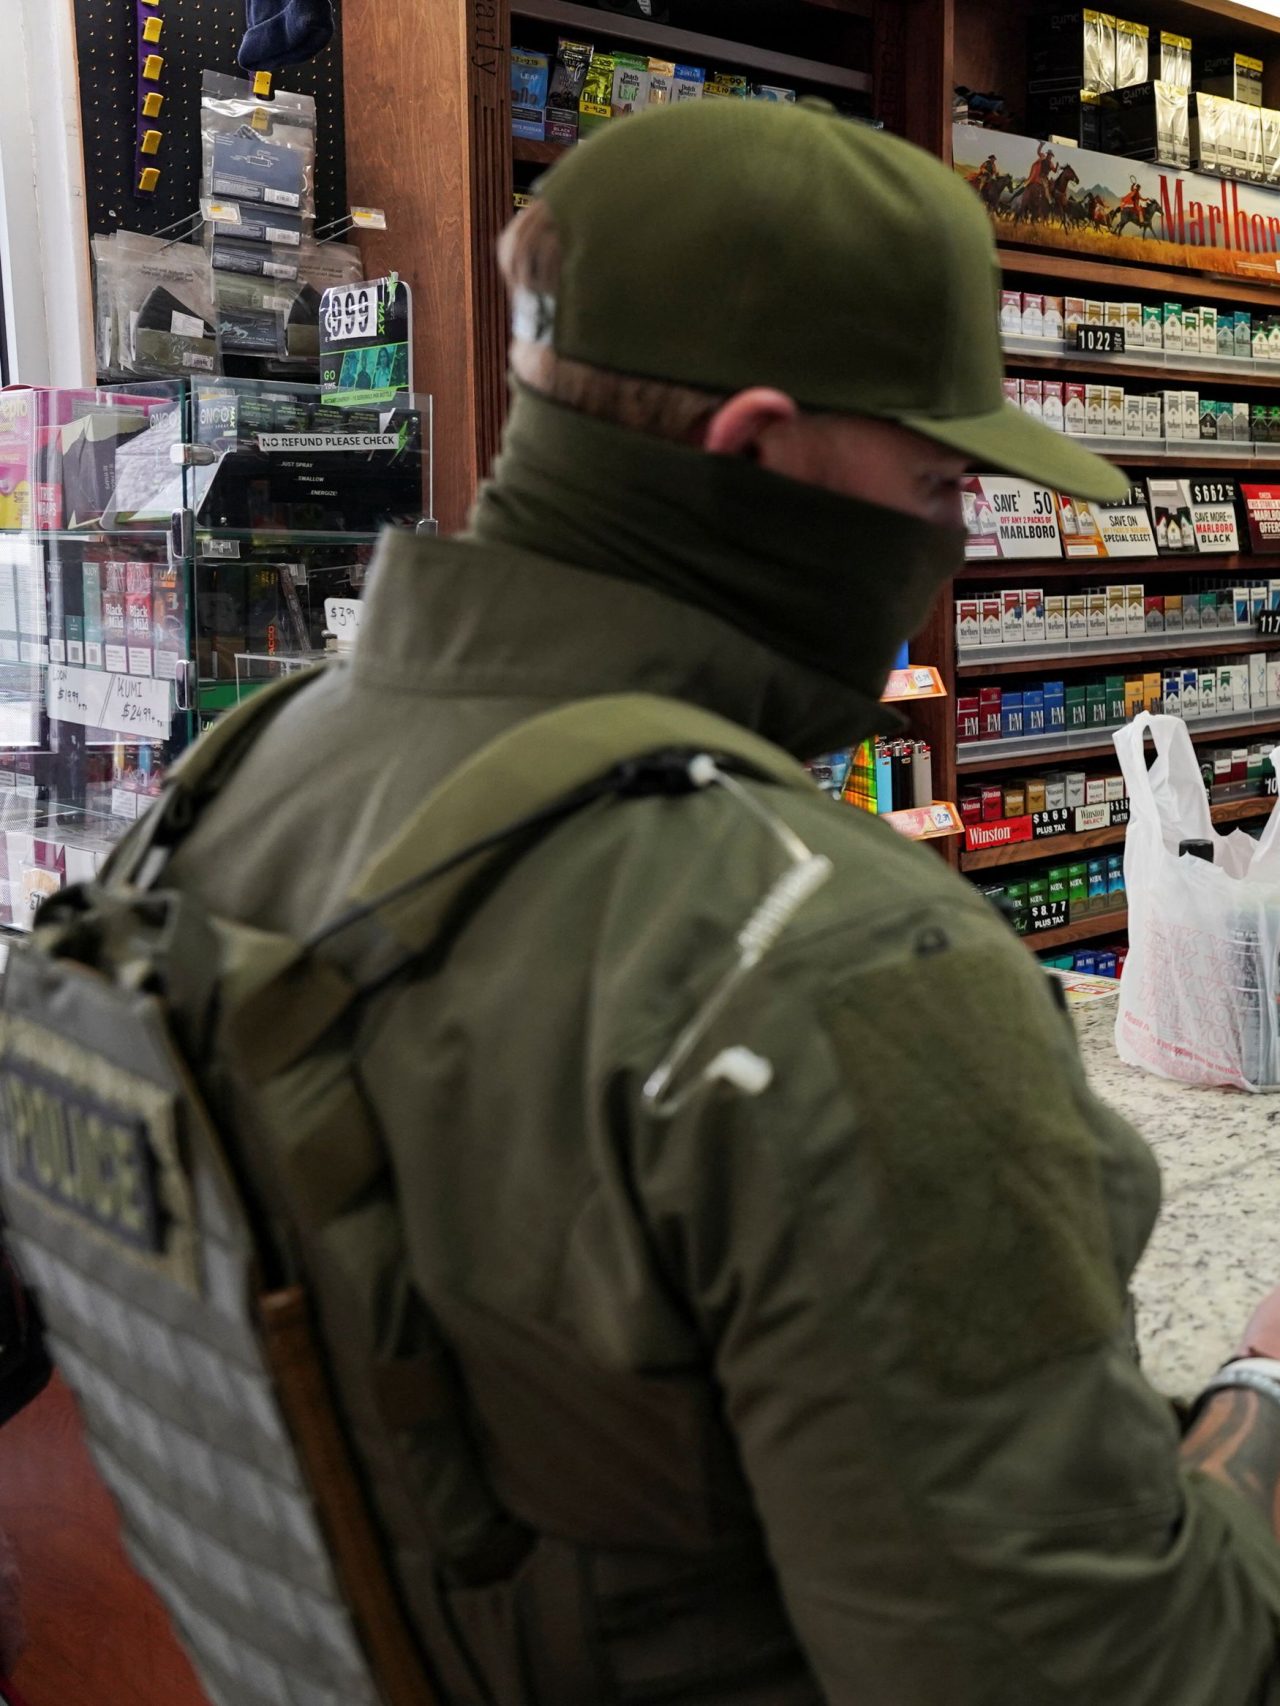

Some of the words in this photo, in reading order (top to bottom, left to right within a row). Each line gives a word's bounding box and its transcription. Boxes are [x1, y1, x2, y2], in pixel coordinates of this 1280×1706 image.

[324, 370, 336, 380] GO
[262, 436, 280, 448] NO
[282, 436, 324, 447] REFUND
[326, 436, 362, 446] PLEASE
[363, 435, 395, 446] CHECK
[993, 494, 1019, 513] SAVE
[1011, 516, 1022, 524] ANY
[1027, 516, 1044, 524] PACKS
[1109, 516, 1126, 527] SAVE
[1126, 515, 1138, 526] ON
[1194, 512, 1208, 522] SAVE
[1208, 512, 1228, 522] MORE
[1000, 526, 1056, 540] MARLBORO
[1195, 523, 1234, 534] MARLBORO
[1104, 534, 1128, 542] SPECIAL
[1130, 534, 1151, 542] SELECT
[1201, 534, 1231, 543] BLACK
[105, 604, 124, 618] Black
[129, 604, 148, 618] Black
[1080, 808, 1105, 820] Winston
[1036, 826, 1052, 836] PLUS
[1054, 823, 1066, 832] TAX
[969, 826, 1011, 846] Winston
[1034, 918, 1051, 929] PLUS
[1052, 916, 1064, 925] TAX
